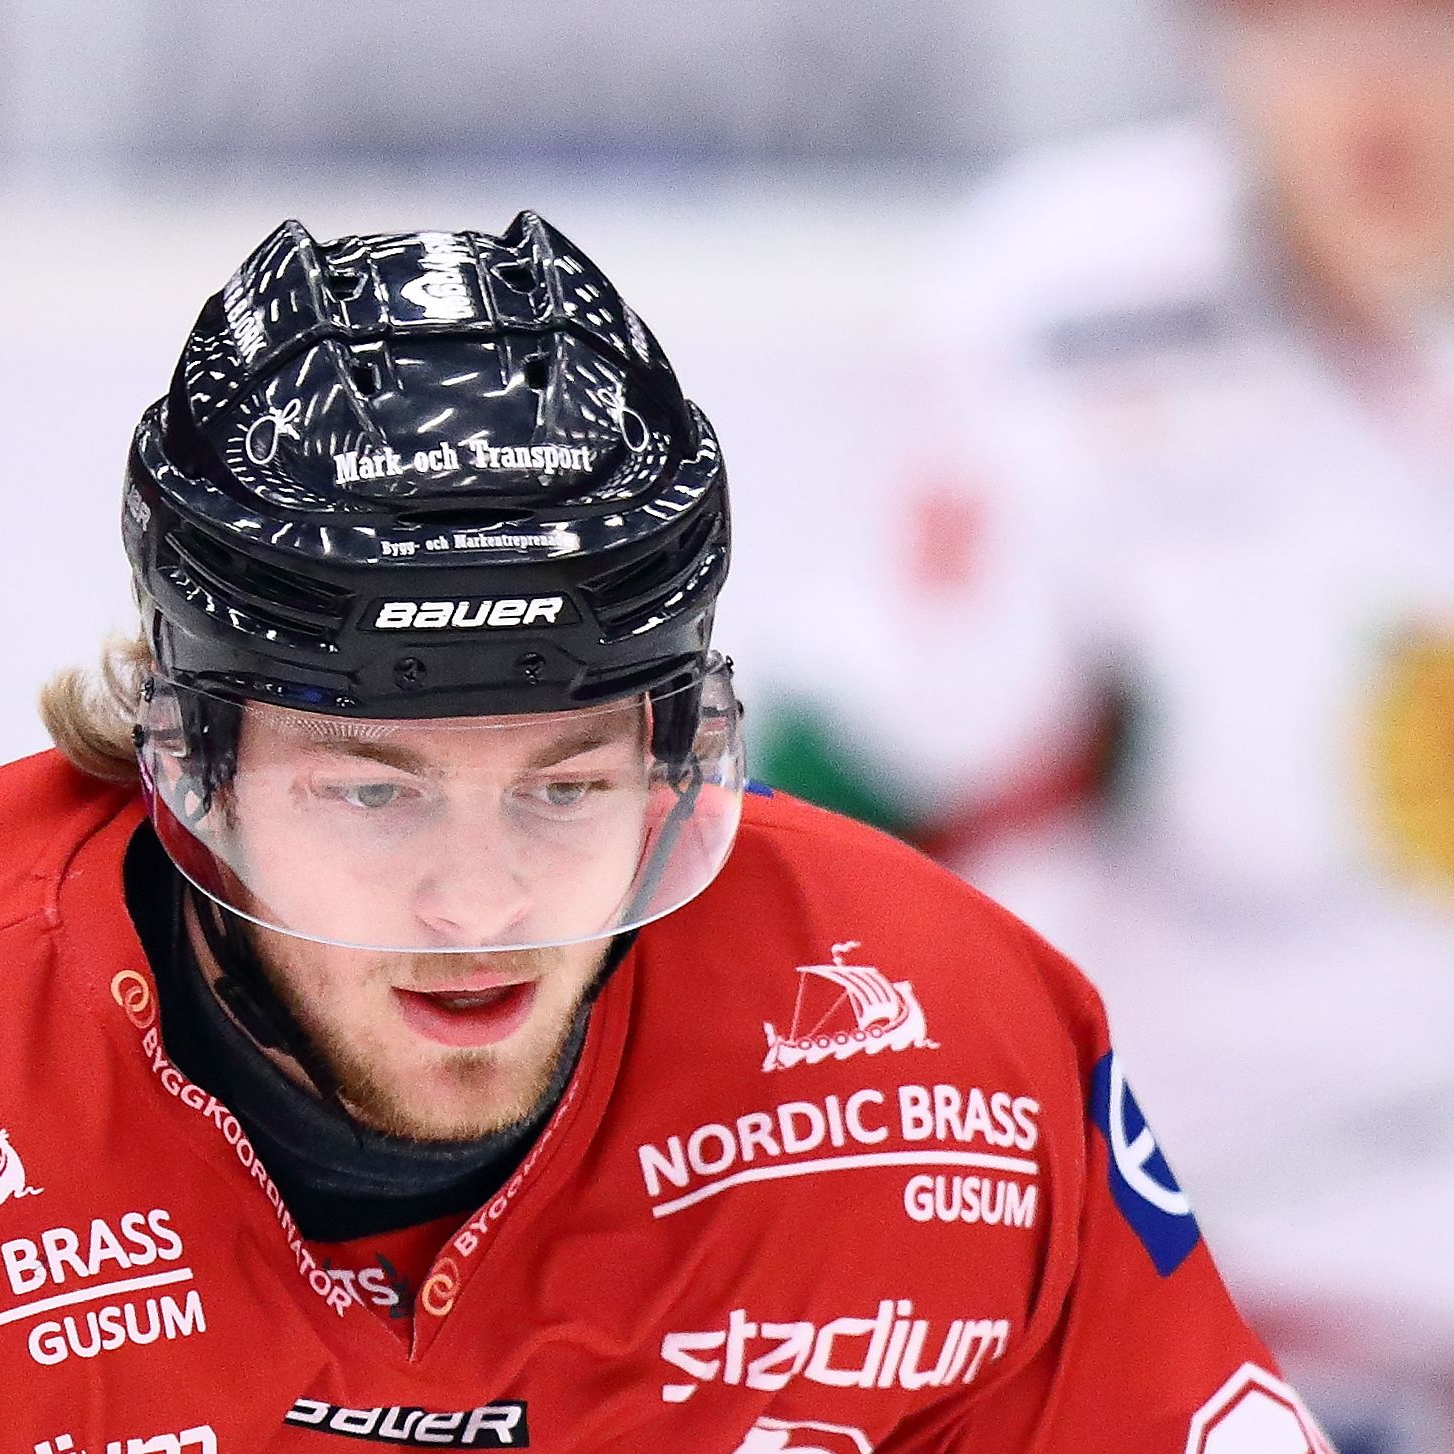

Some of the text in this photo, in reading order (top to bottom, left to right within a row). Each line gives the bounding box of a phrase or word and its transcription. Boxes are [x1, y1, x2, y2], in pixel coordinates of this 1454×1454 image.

[333, 438, 593, 485] Mark och Transport
[425, 535, 450, 551] och
[452, 533, 579, 551] Markentreprena
[637, 1089, 887, 1198] NORDIC
[896, 1083, 1041, 1152] BRASS
[903, 1174, 1038, 1229] GUSUM
[1, 1208, 184, 1296] BRASS
[28, 1290, 207, 1366] GUSUM
[660, 1298, 1011, 1403] stadium
